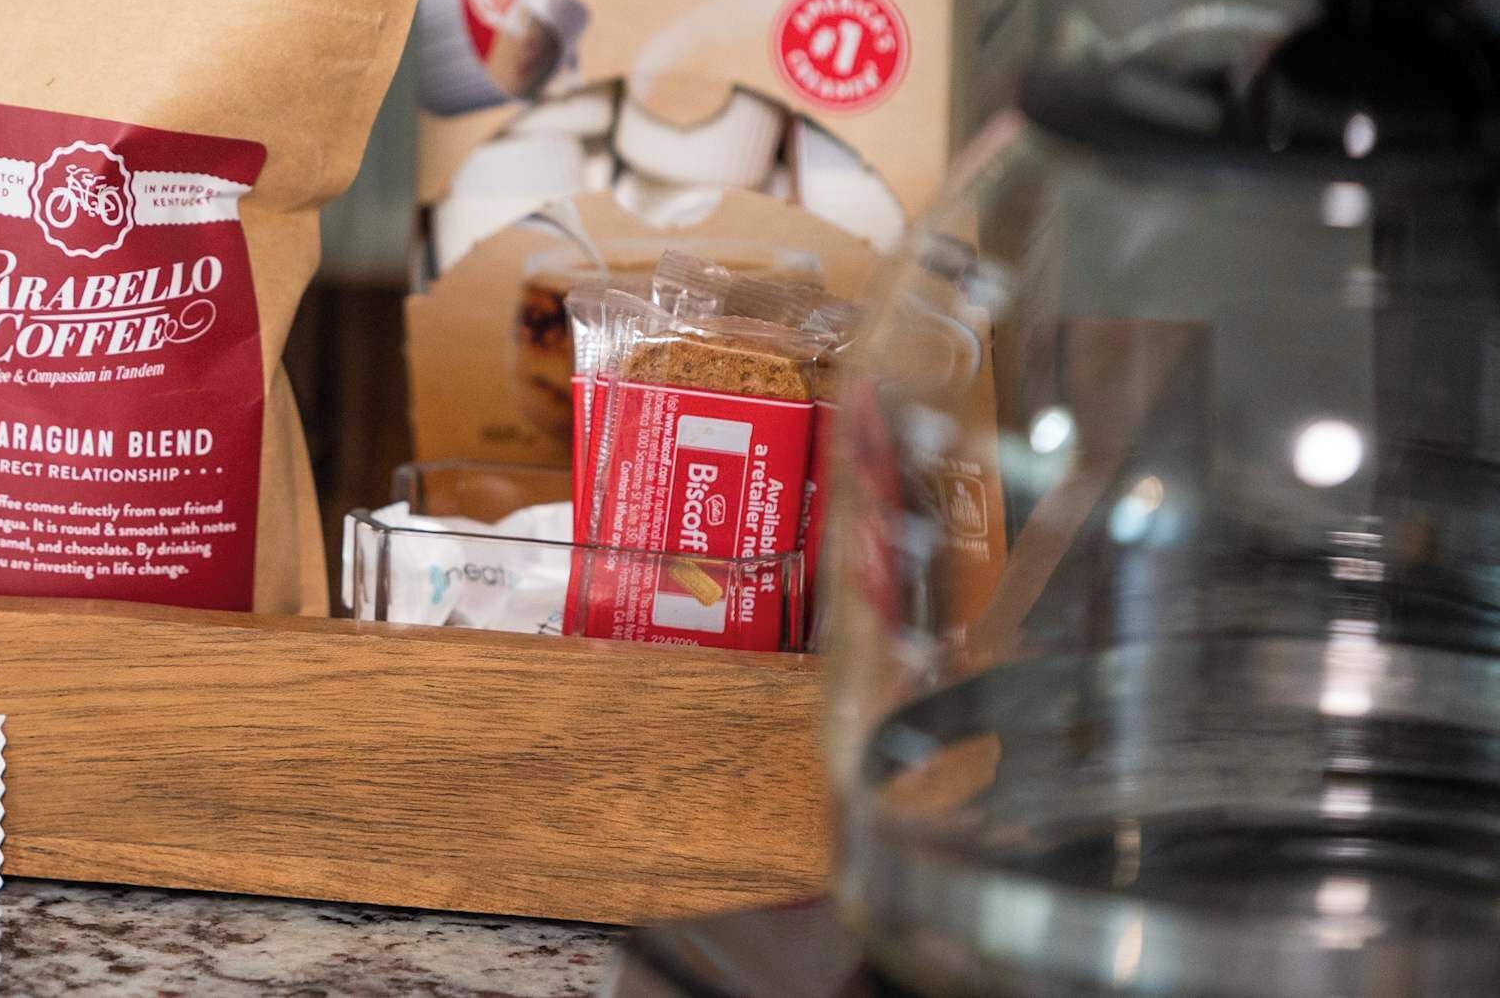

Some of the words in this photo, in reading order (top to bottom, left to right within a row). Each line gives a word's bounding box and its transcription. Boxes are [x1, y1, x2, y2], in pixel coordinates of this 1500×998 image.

[144, 184, 156, 194] IN
[26, 367, 96, 388] Compassion
[98, 365, 112, 381] in
[115, 363, 165, 381] Tandem
[667, 394, 679, 412] Visit
[128, 428, 214, 458] BLEND
[658, 412, 675, 485] www.biscoff.com
[755, 444, 768, 456] a
[48, 464, 180, 482] RELATIONSHIP
[618, 461, 632, 500] Contains
[745, 460, 767, 532] retailer
[24, 501, 66, 516] comes
[68, 502, 120, 521] directly
[123, 503, 156, 517] from
[159, 506, 181, 517] our
[184, 499, 223, 515] friend
[614, 502, 627, 532] Wheat
[679, 463, 719, 552] Biscoff
[32, 518, 45, 533] It
[47, 520, 58, 534] is
[60, 522, 100, 536] round
[103, 522, 116, 537] &
[118, 522, 169, 537] smooth
[171, 520, 200, 535] with
[202, 520, 237, 534] notes
[37, 539, 62, 554] and
[64, 540, 133, 556] chocolate.
[136, 542, 154, 560] By
[156, 541, 212, 558] drinking
[10, 558, 31, 572] are
[33, 558, 94, 580] investing
[97, 560, 110, 575] in
[113, 562, 136, 576] life
[137, 562, 189, 580] change.
[760, 572, 776, 592] at
[740, 586, 756, 622] you
